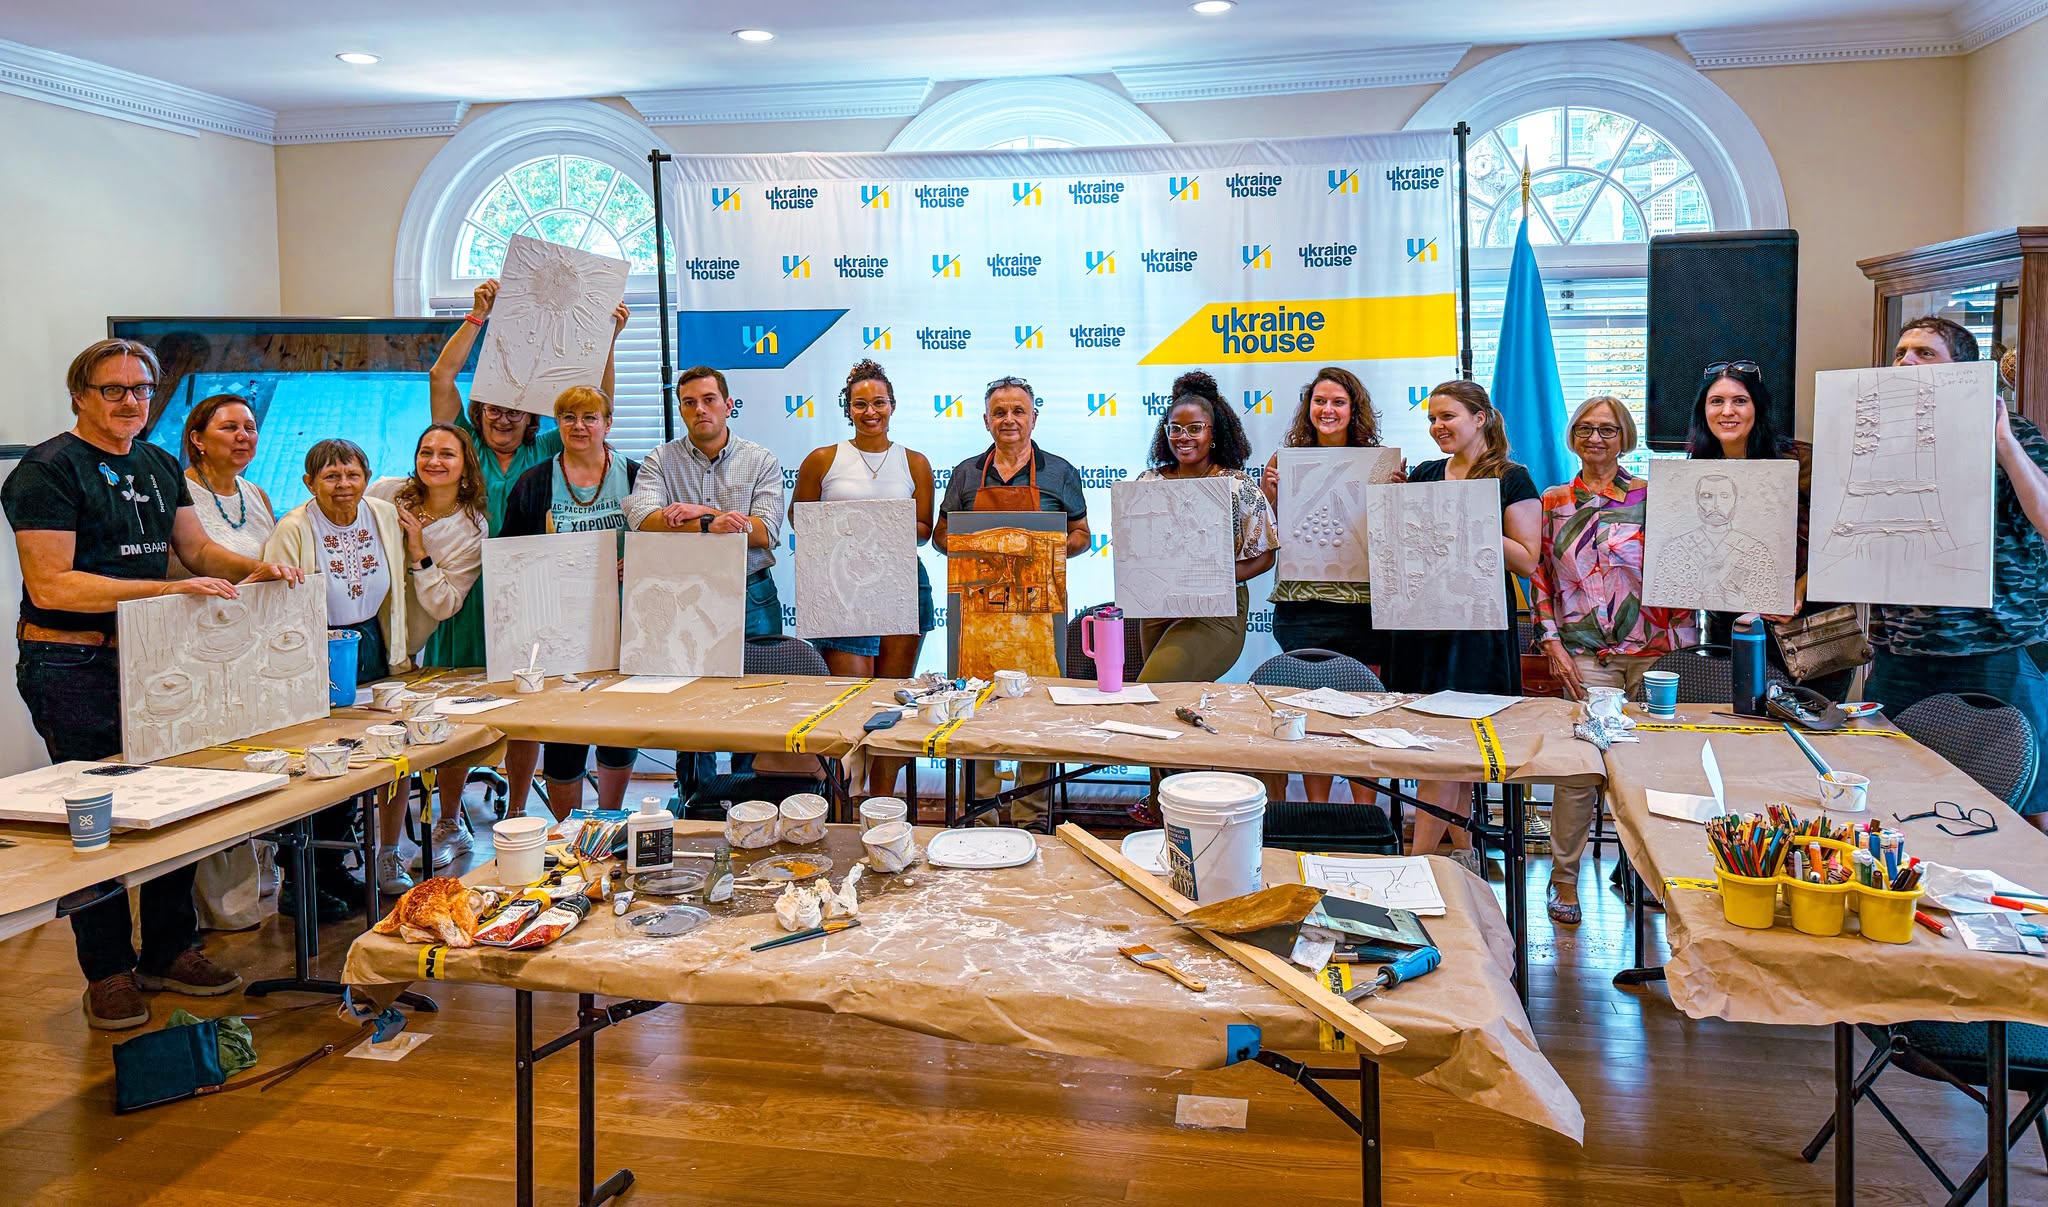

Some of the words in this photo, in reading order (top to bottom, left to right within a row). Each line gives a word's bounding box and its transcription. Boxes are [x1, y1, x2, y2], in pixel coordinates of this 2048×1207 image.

[1386, 165, 1444, 180] ukraine
[1226, 172, 1282, 187] ukraine
[1392, 179, 1439, 191] house
[766, 186, 818, 199] ukraine
[915, 184, 969, 197] ukraine
[1069, 180, 1124, 193] ukraine
[1232, 186, 1277, 198] house
[771, 198, 813, 209] house
[921, 197, 964, 208] house
[1074, 193, 1119, 204] house
[1142, 248, 1197, 261] ukraine
[1299, 242, 1357, 256] ukraine
[686, 257, 740, 270] ukraine
[834, 255, 888, 268] ukraine
[987, 253, 1041, 266] ukraine
[1304, 255, 1352, 267] house
[840, 267, 883, 278] house
[993, 265, 1036, 276] house
[1147, 261, 1192, 272] house
[692, 269, 735, 280] house
[1212, 306, 1325, 332] ukraine
[917, 327, 971, 339] ukraine
[1070, 324, 1125, 337] ukraine
[922, 339, 966, 349] house
[1076, 336, 1120, 347] house
[1224, 331, 1314, 353] house
[1142, 392, 1174, 405] ukra
